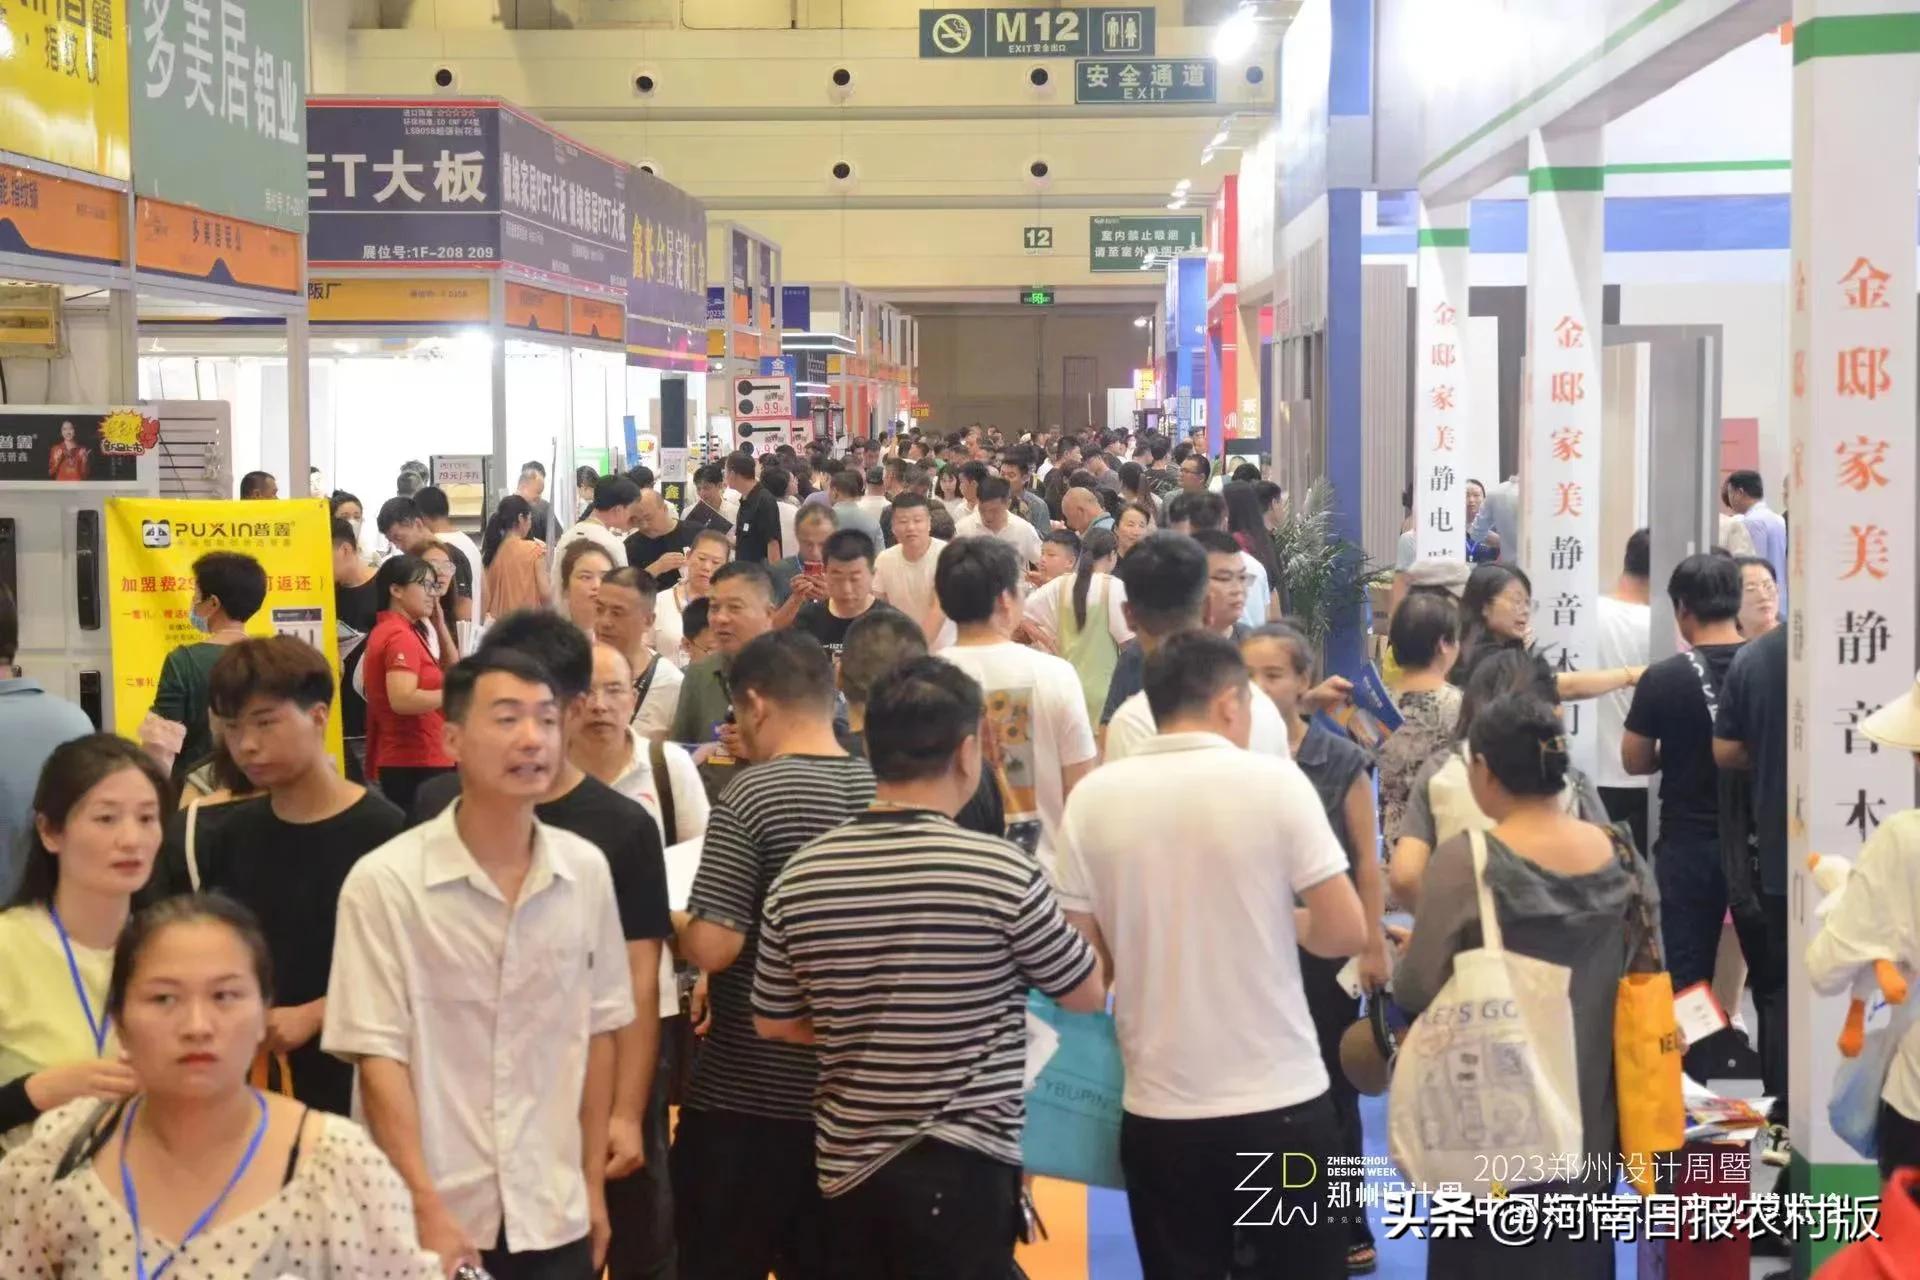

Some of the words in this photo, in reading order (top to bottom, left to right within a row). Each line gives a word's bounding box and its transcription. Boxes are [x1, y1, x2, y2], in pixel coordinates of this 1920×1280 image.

[1087, 64, 1205, 88] 安全通道
[1123, 87, 1168, 99] EXIT
[1026, 230, 1050, 246] 12
[1101, 229, 1178, 241] 室内禁止吸烟
[468, 247, 494, 259] 209
